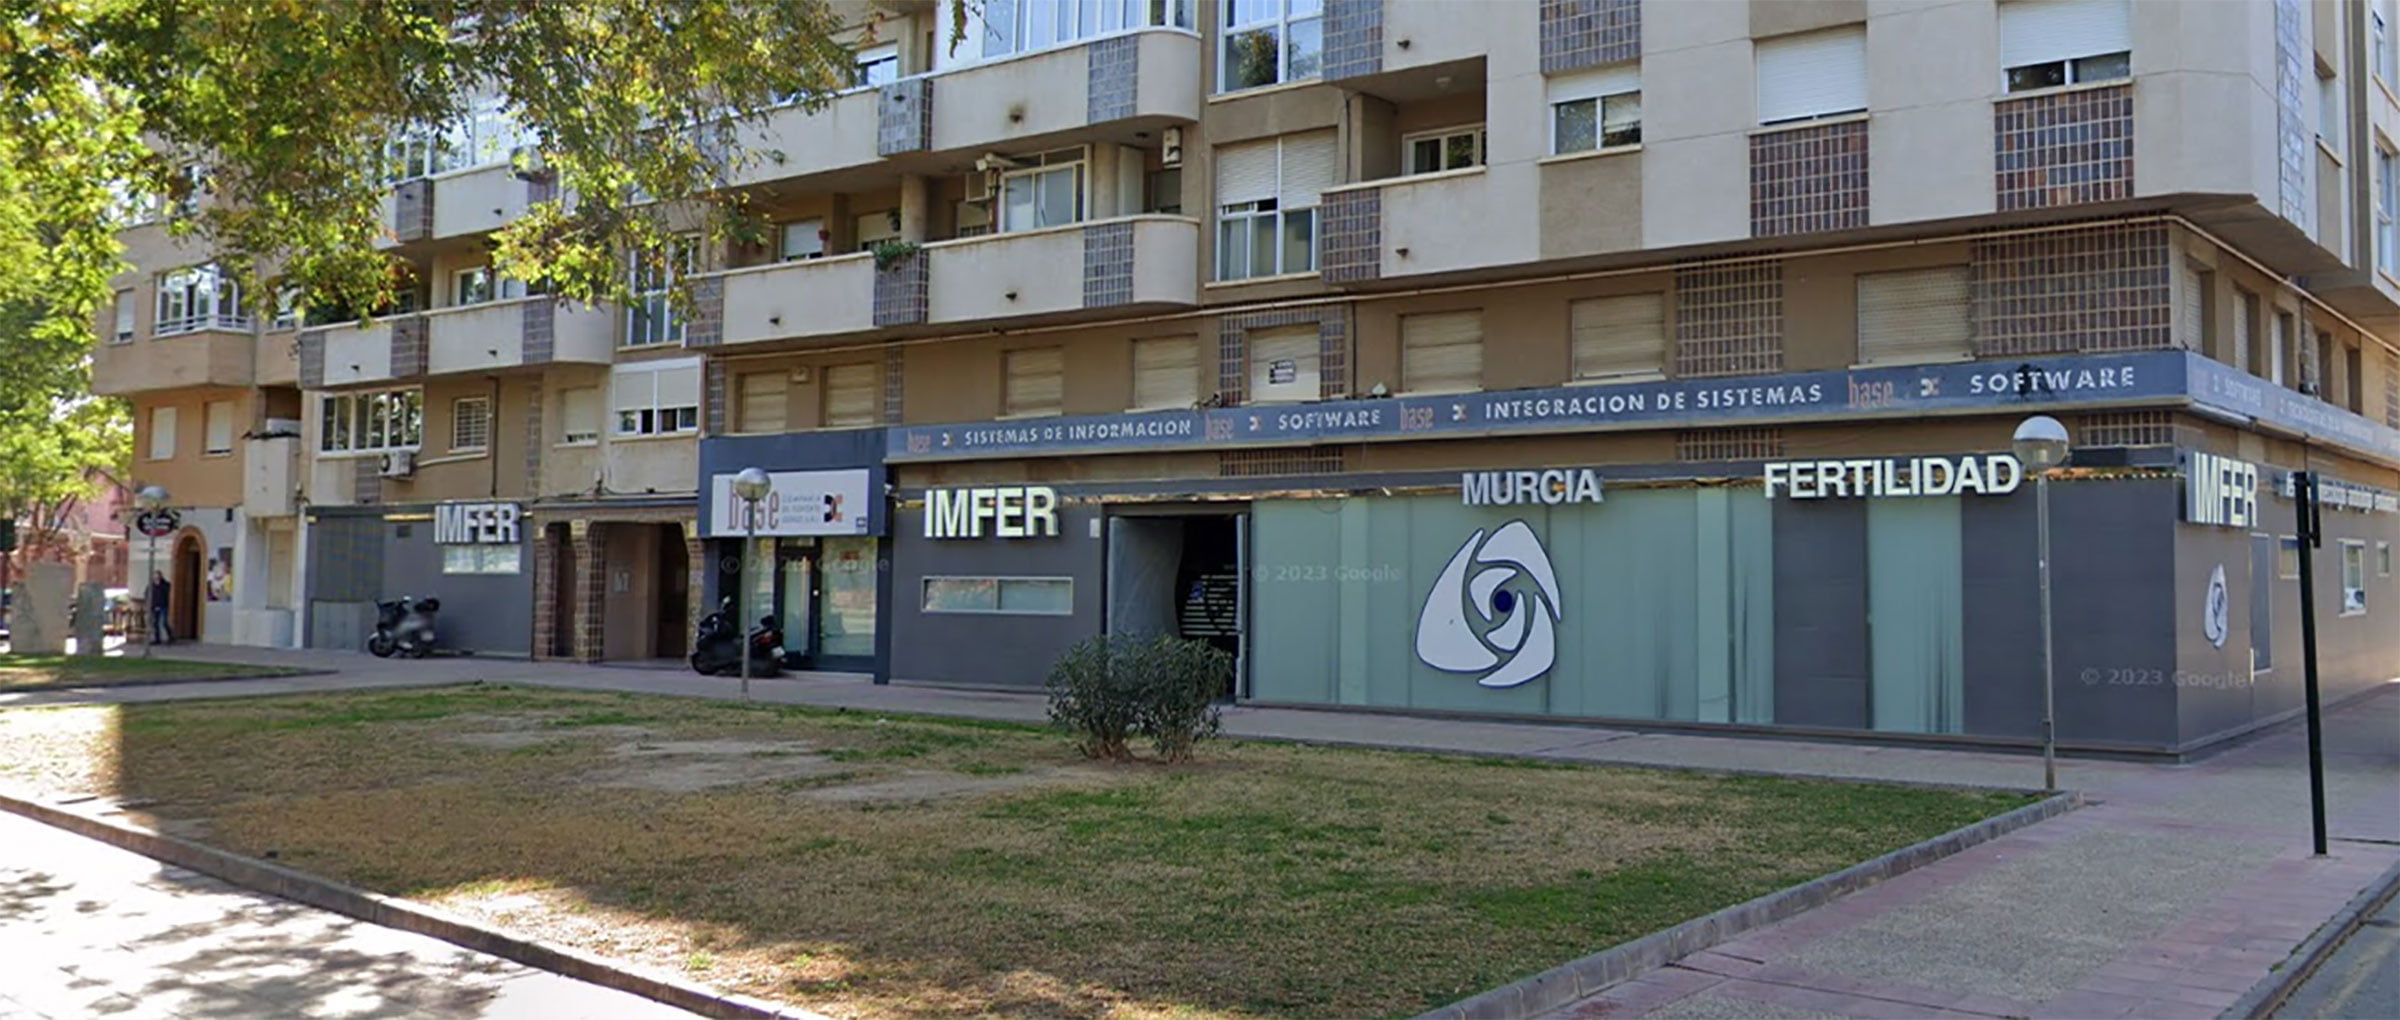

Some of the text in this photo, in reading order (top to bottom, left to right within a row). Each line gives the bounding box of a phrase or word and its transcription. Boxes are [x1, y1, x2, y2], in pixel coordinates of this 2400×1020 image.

[965, 427, 1037, 445] SISTEMAS
[1044, 426, 1063, 441] DE
[1069, 420, 1191, 440] INFORMACION
[1278, 409, 1381, 430] SOFTWARE
[1400, 402, 1433, 431] base
[1485, 394, 1645, 419] INTEGRACION
[1657, 391, 1685, 411] DE
[1697, 384, 1823, 408] SISTEMAS
[1848, 374, 1894, 408] base
[1970, 366, 2135, 394] SOFTWARE
[1462, 469, 1604, 505] MURCIA
[1764, 454, 2022, 499] FERTILIDAD
[2194, 451, 2259, 527] IMFER
[434, 503, 520, 543] IMFER
[727, 479, 780, 530] base
[924, 486, 1060, 537] IMFER
